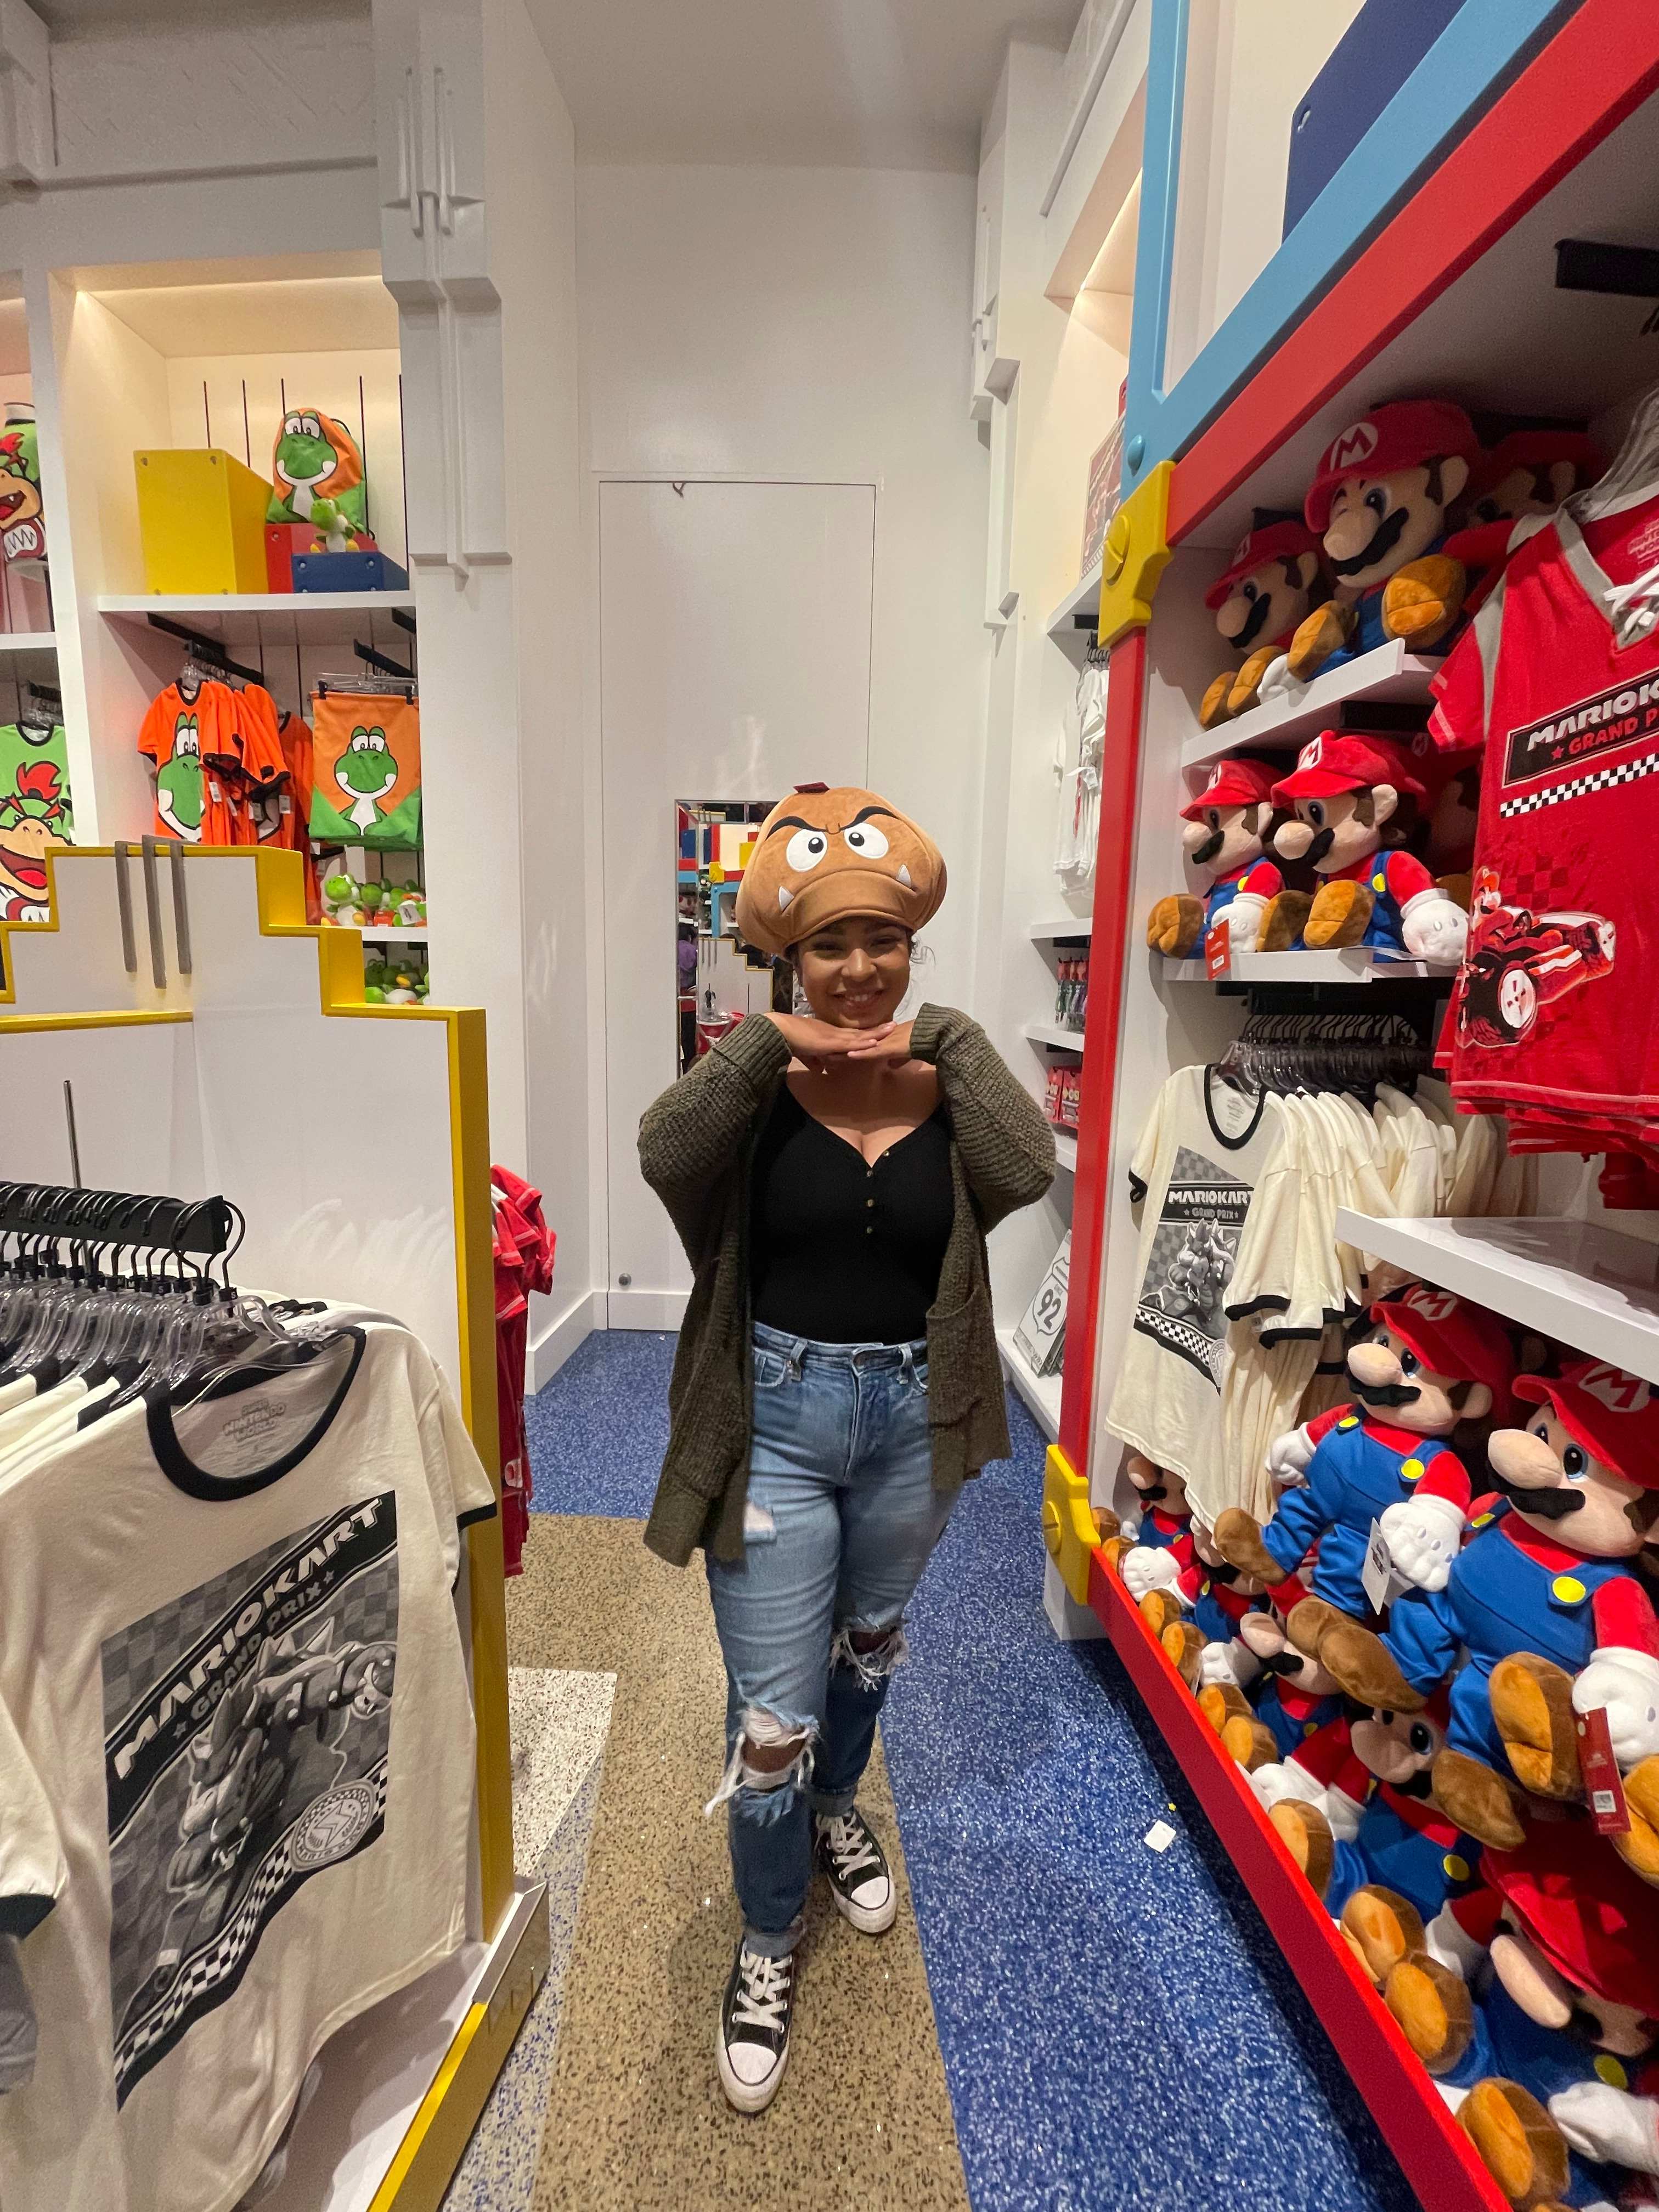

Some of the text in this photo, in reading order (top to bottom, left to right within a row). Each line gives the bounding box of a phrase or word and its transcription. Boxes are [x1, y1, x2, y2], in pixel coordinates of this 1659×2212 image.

[1567, 716, 1638, 754] GRAND
[1192, 1207, 1234, 1220] GRAND PRIX
[230, 1290, 236, 1300] S
[1037, 1288, 1061, 1330] 92
[190, 1581, 323, 1720] GRAND PRIX
